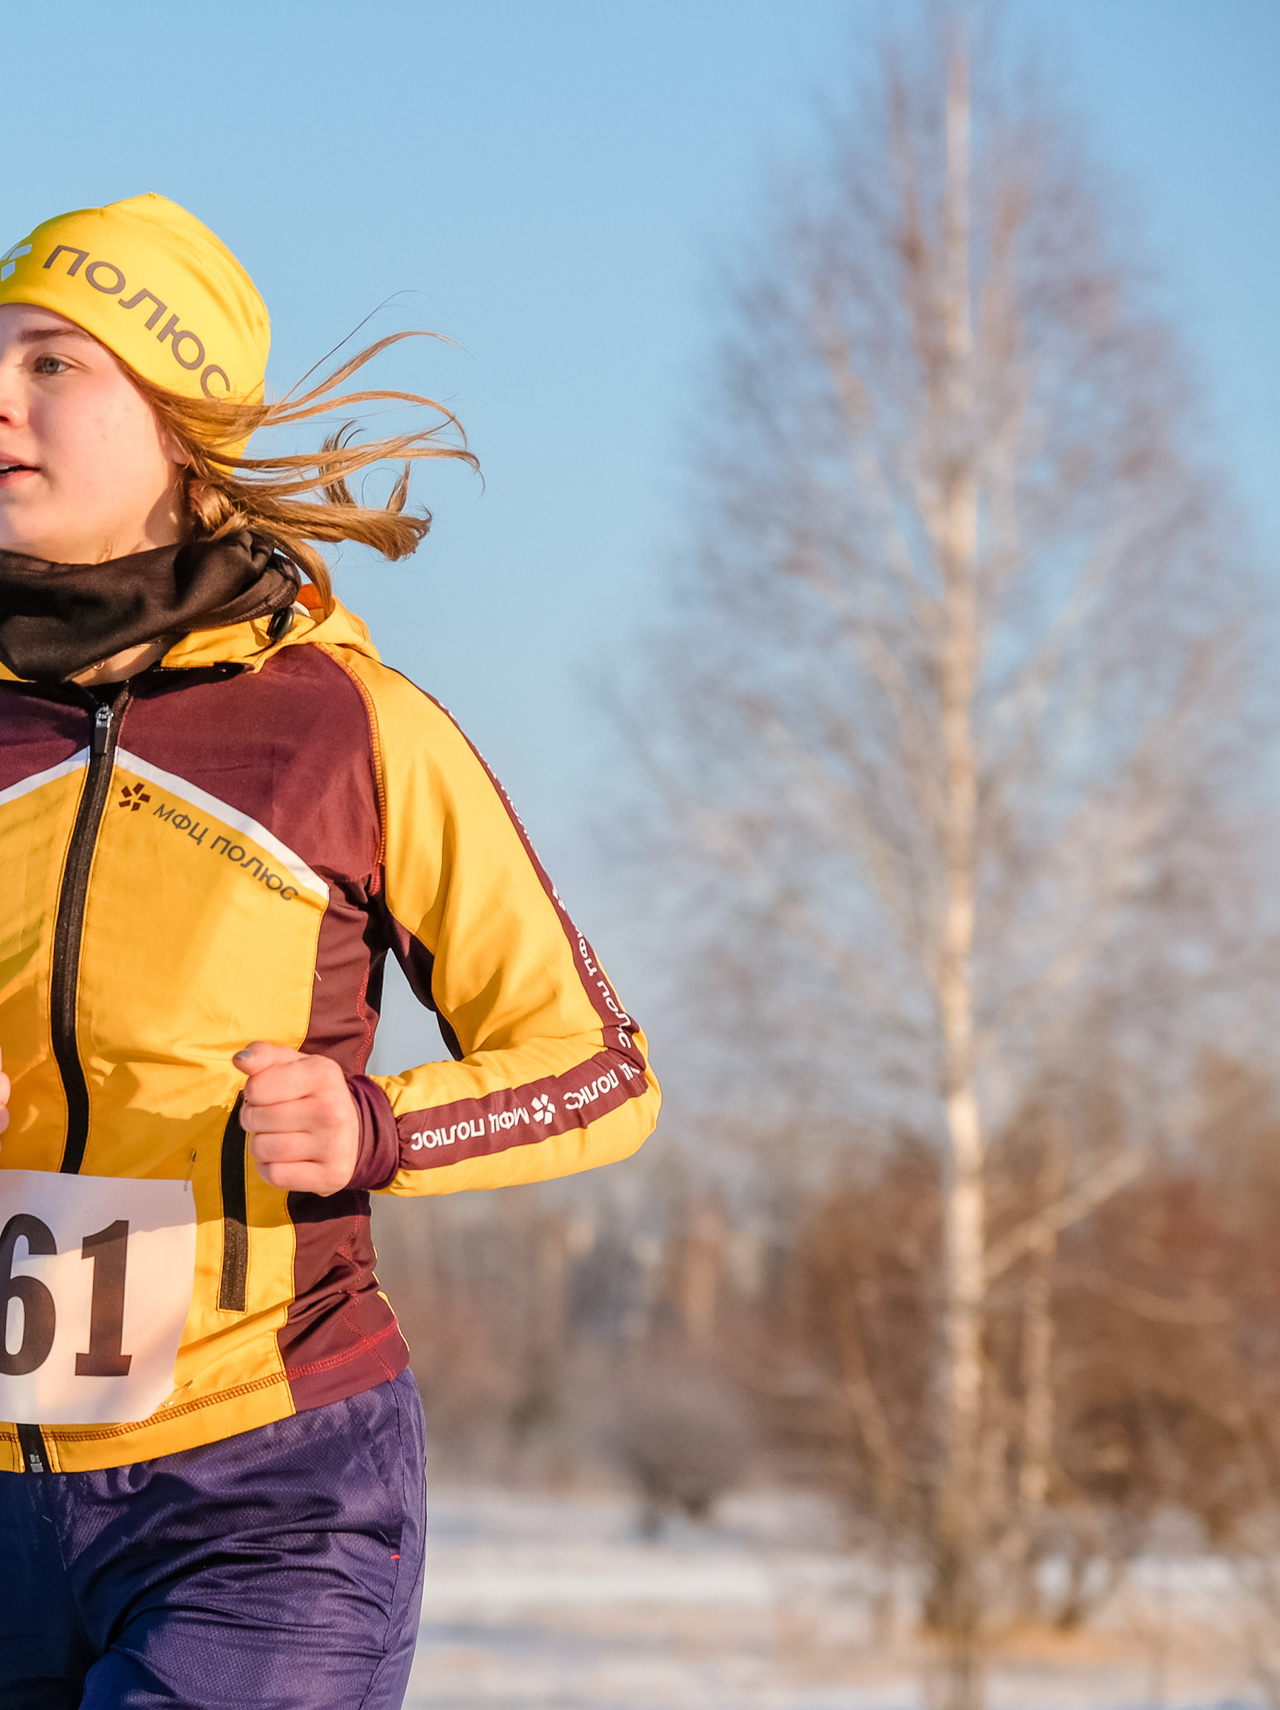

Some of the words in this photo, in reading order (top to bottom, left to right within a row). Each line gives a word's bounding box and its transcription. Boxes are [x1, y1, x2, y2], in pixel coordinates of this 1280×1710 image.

[43, 244, 231, 401] ПОЛЮС
[153, 803, 209, 845] МФЦ
[210, 834, 299, 901] ПОЛЮС
[597, 980, 631, 1048] ПОЛС
[410, 1118, 485, 1150] ПОЛЮС
[488, 1107, 530, 1134] МФЦ
